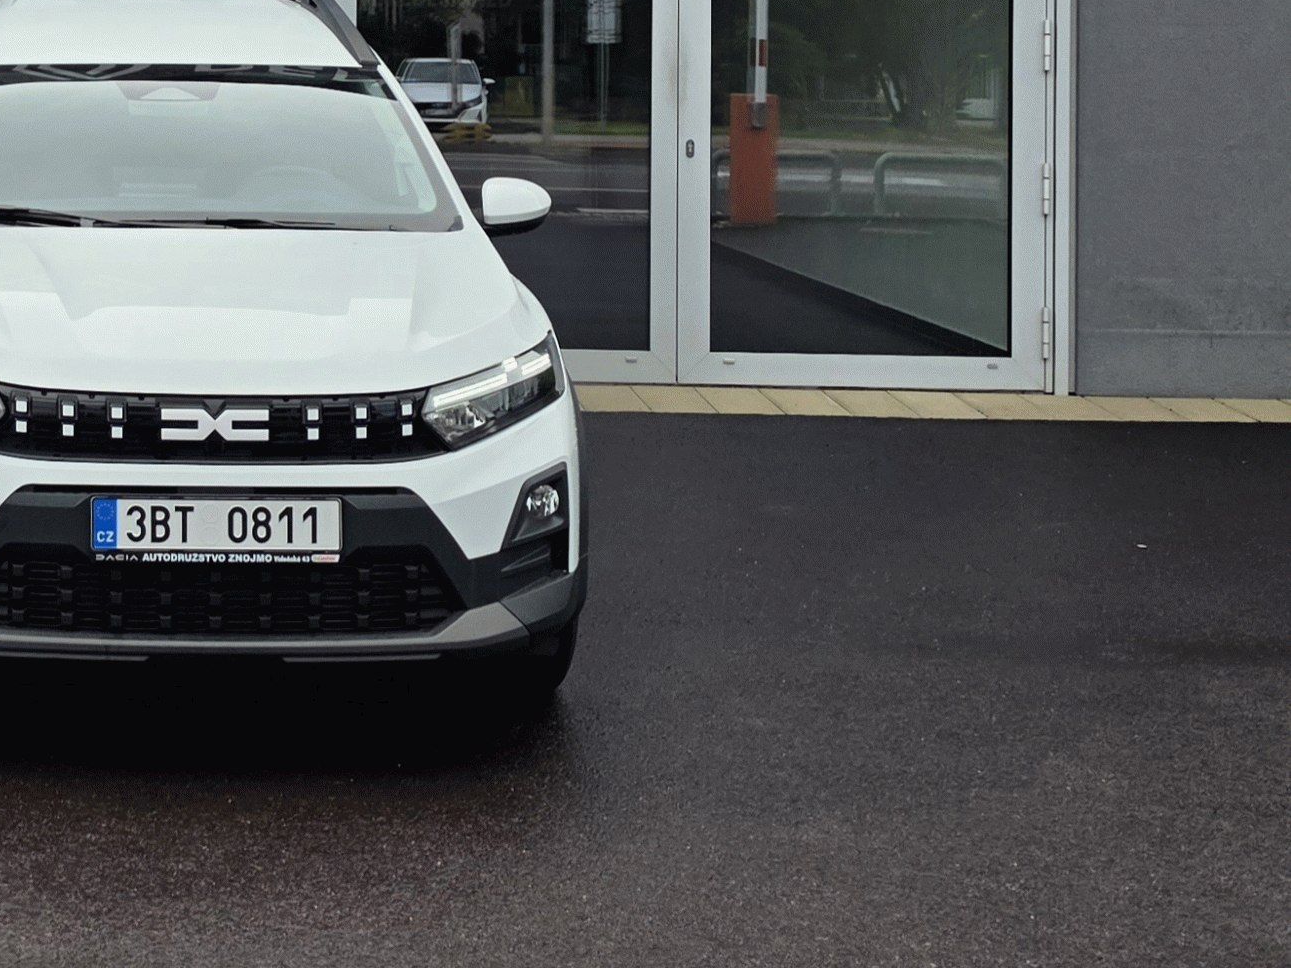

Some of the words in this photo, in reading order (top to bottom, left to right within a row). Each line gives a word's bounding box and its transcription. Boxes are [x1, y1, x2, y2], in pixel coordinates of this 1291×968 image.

[126, 505, 195, 544] 3BT
[227, 506, 318, 545] 0811
[96, 531, 114, 543] CZ
[228, 553, 273, 564] ZNOJMO
